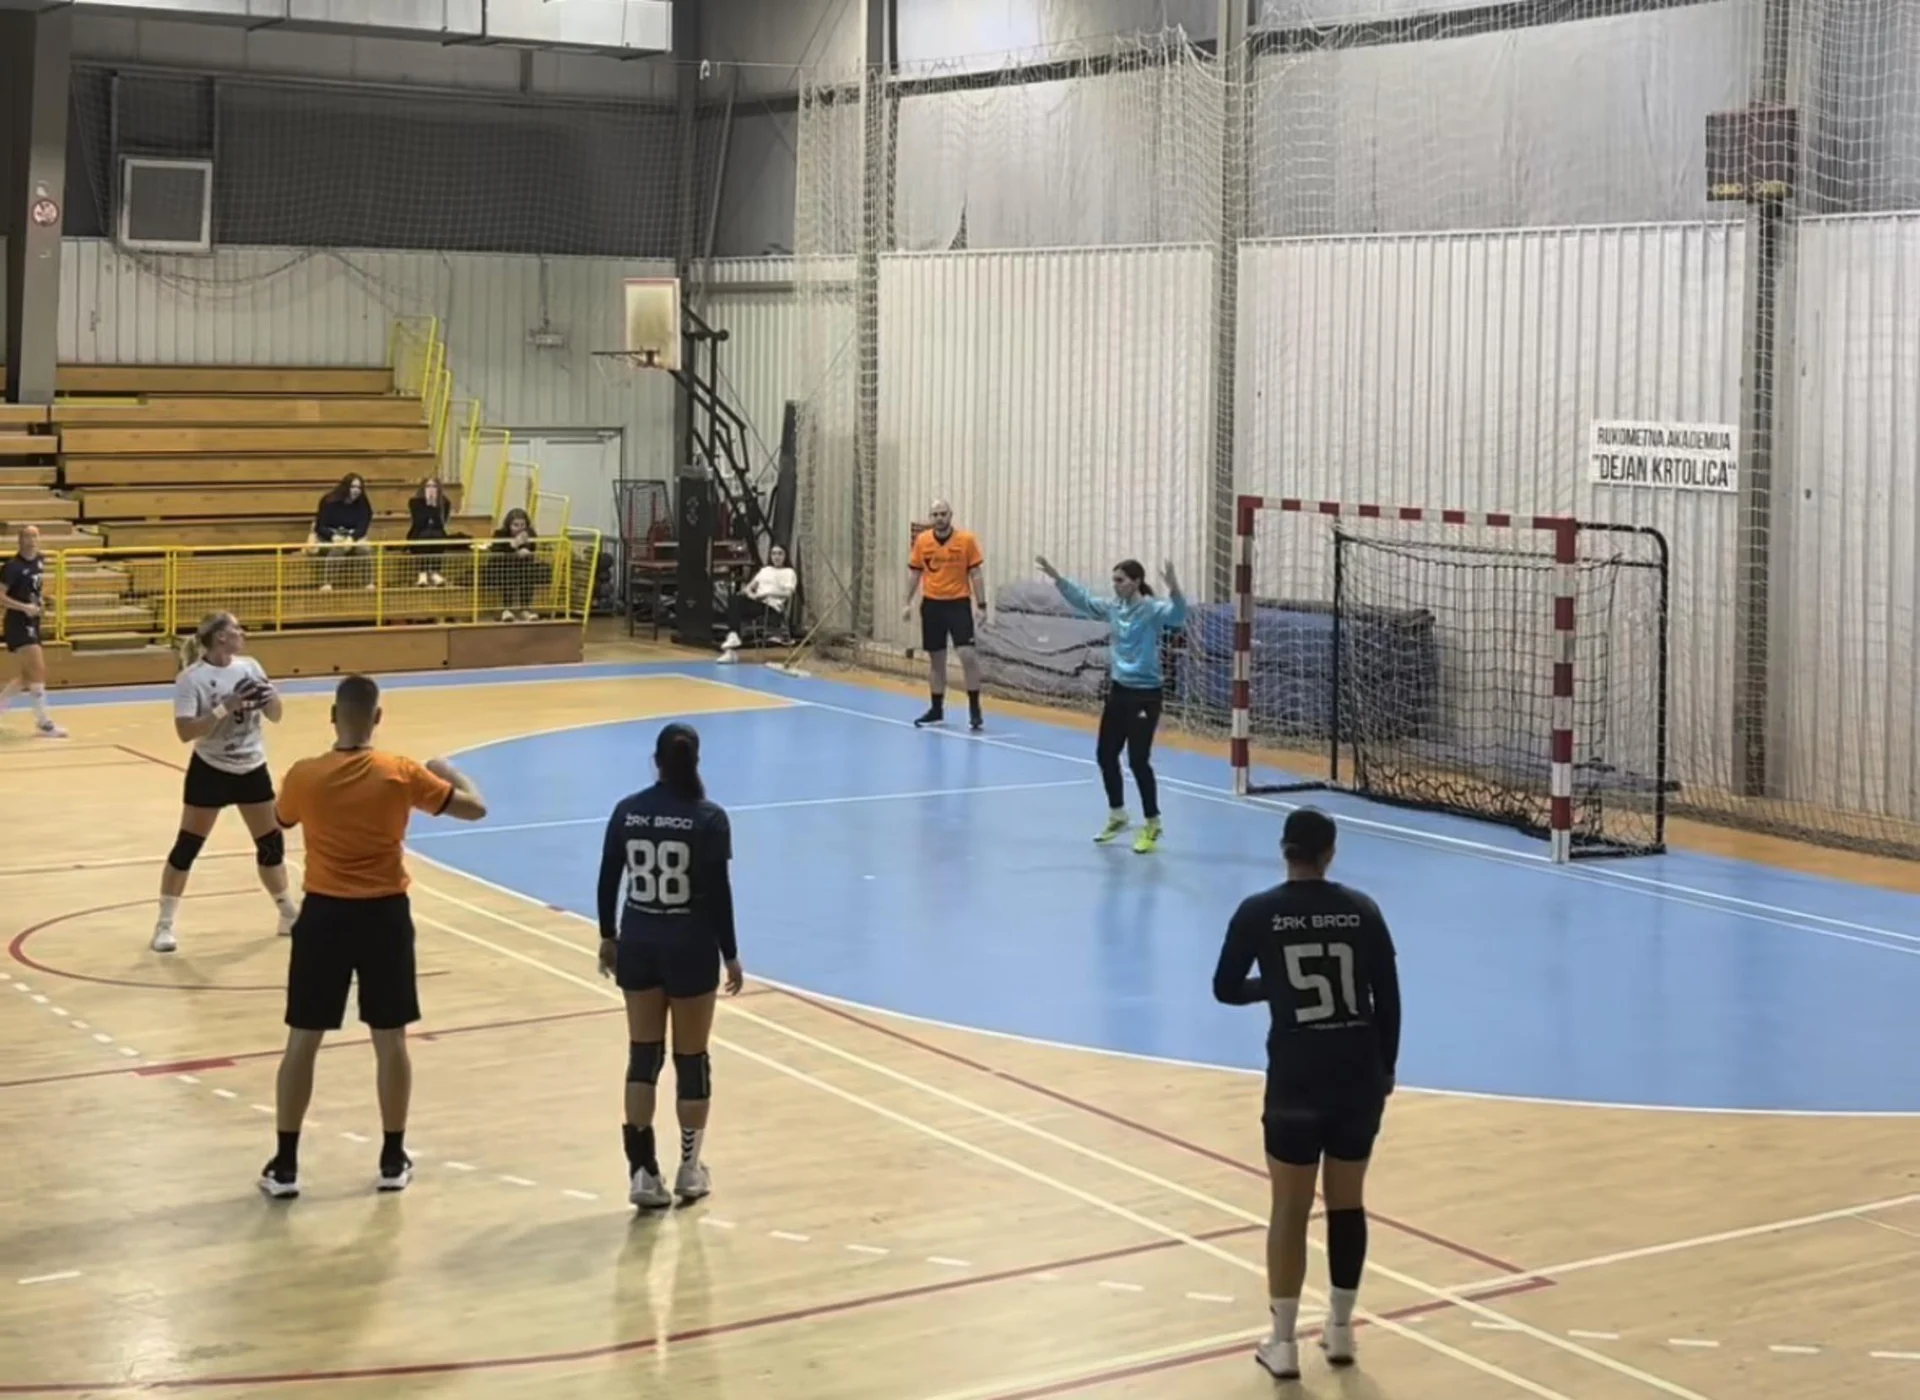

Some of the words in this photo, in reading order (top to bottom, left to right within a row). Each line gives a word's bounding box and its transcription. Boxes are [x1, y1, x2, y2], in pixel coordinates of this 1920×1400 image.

[1597, 427, 1665, 447] RUKOMETNA
[1667, 430, 1731, 450] AKADEMIJA
[626, 839, 690, 904] 88
[1271, 914, 1307, 931] ŽRK
[1283, 942, 1358, 1022] 51
